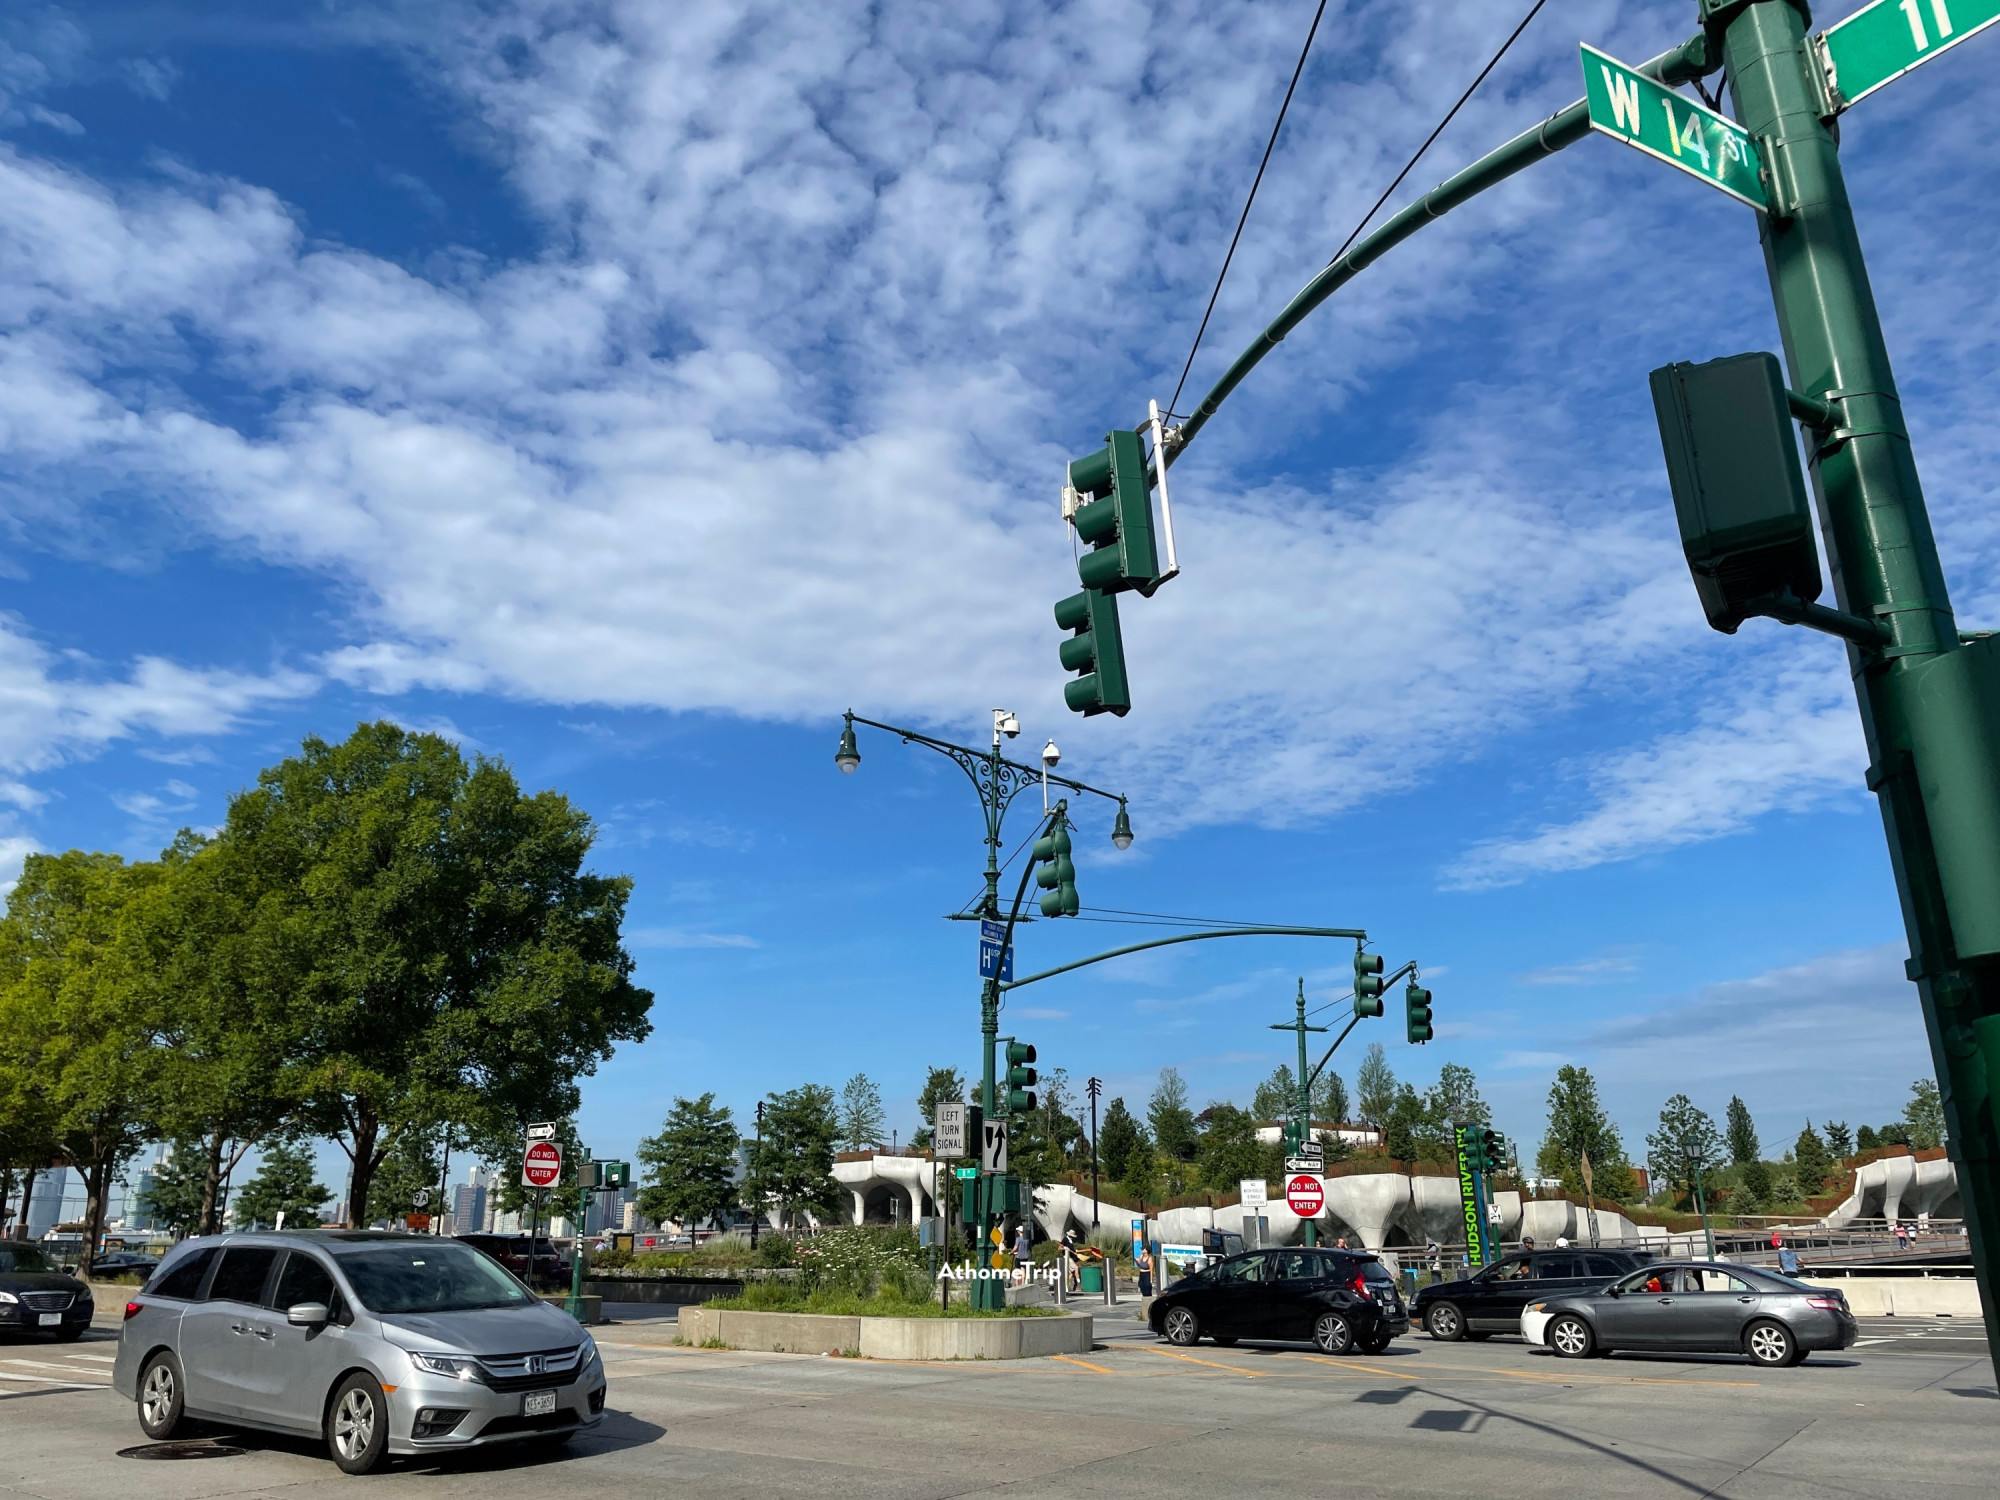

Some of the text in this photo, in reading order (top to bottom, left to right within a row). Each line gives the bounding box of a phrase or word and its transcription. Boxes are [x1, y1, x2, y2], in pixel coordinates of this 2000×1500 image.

[1899, 0, 1953, 52] 11
[1601, 64, 1749, 171] W 14 ST
[982, 946, 1011, 969] HOSPL
[941, 1110, 959, 1121] LEFT
[941, 1124, 960, 1135] TURN
[937, 1139, 963, 1149] SIGNAL
[531, 1150, 555, 1159] DO NOT
[530, 1169, 552, 1178] ENTER
[1458, 1151, 1474, 1197] RIVER
[1291, 1182, 1319, 1191] DO NOT
[414, 1193, 427, 1204] 9A
[1294, 1201, 1317, 1210] ENTER
[1464, 1201, 1482, 1266] HUDSON
